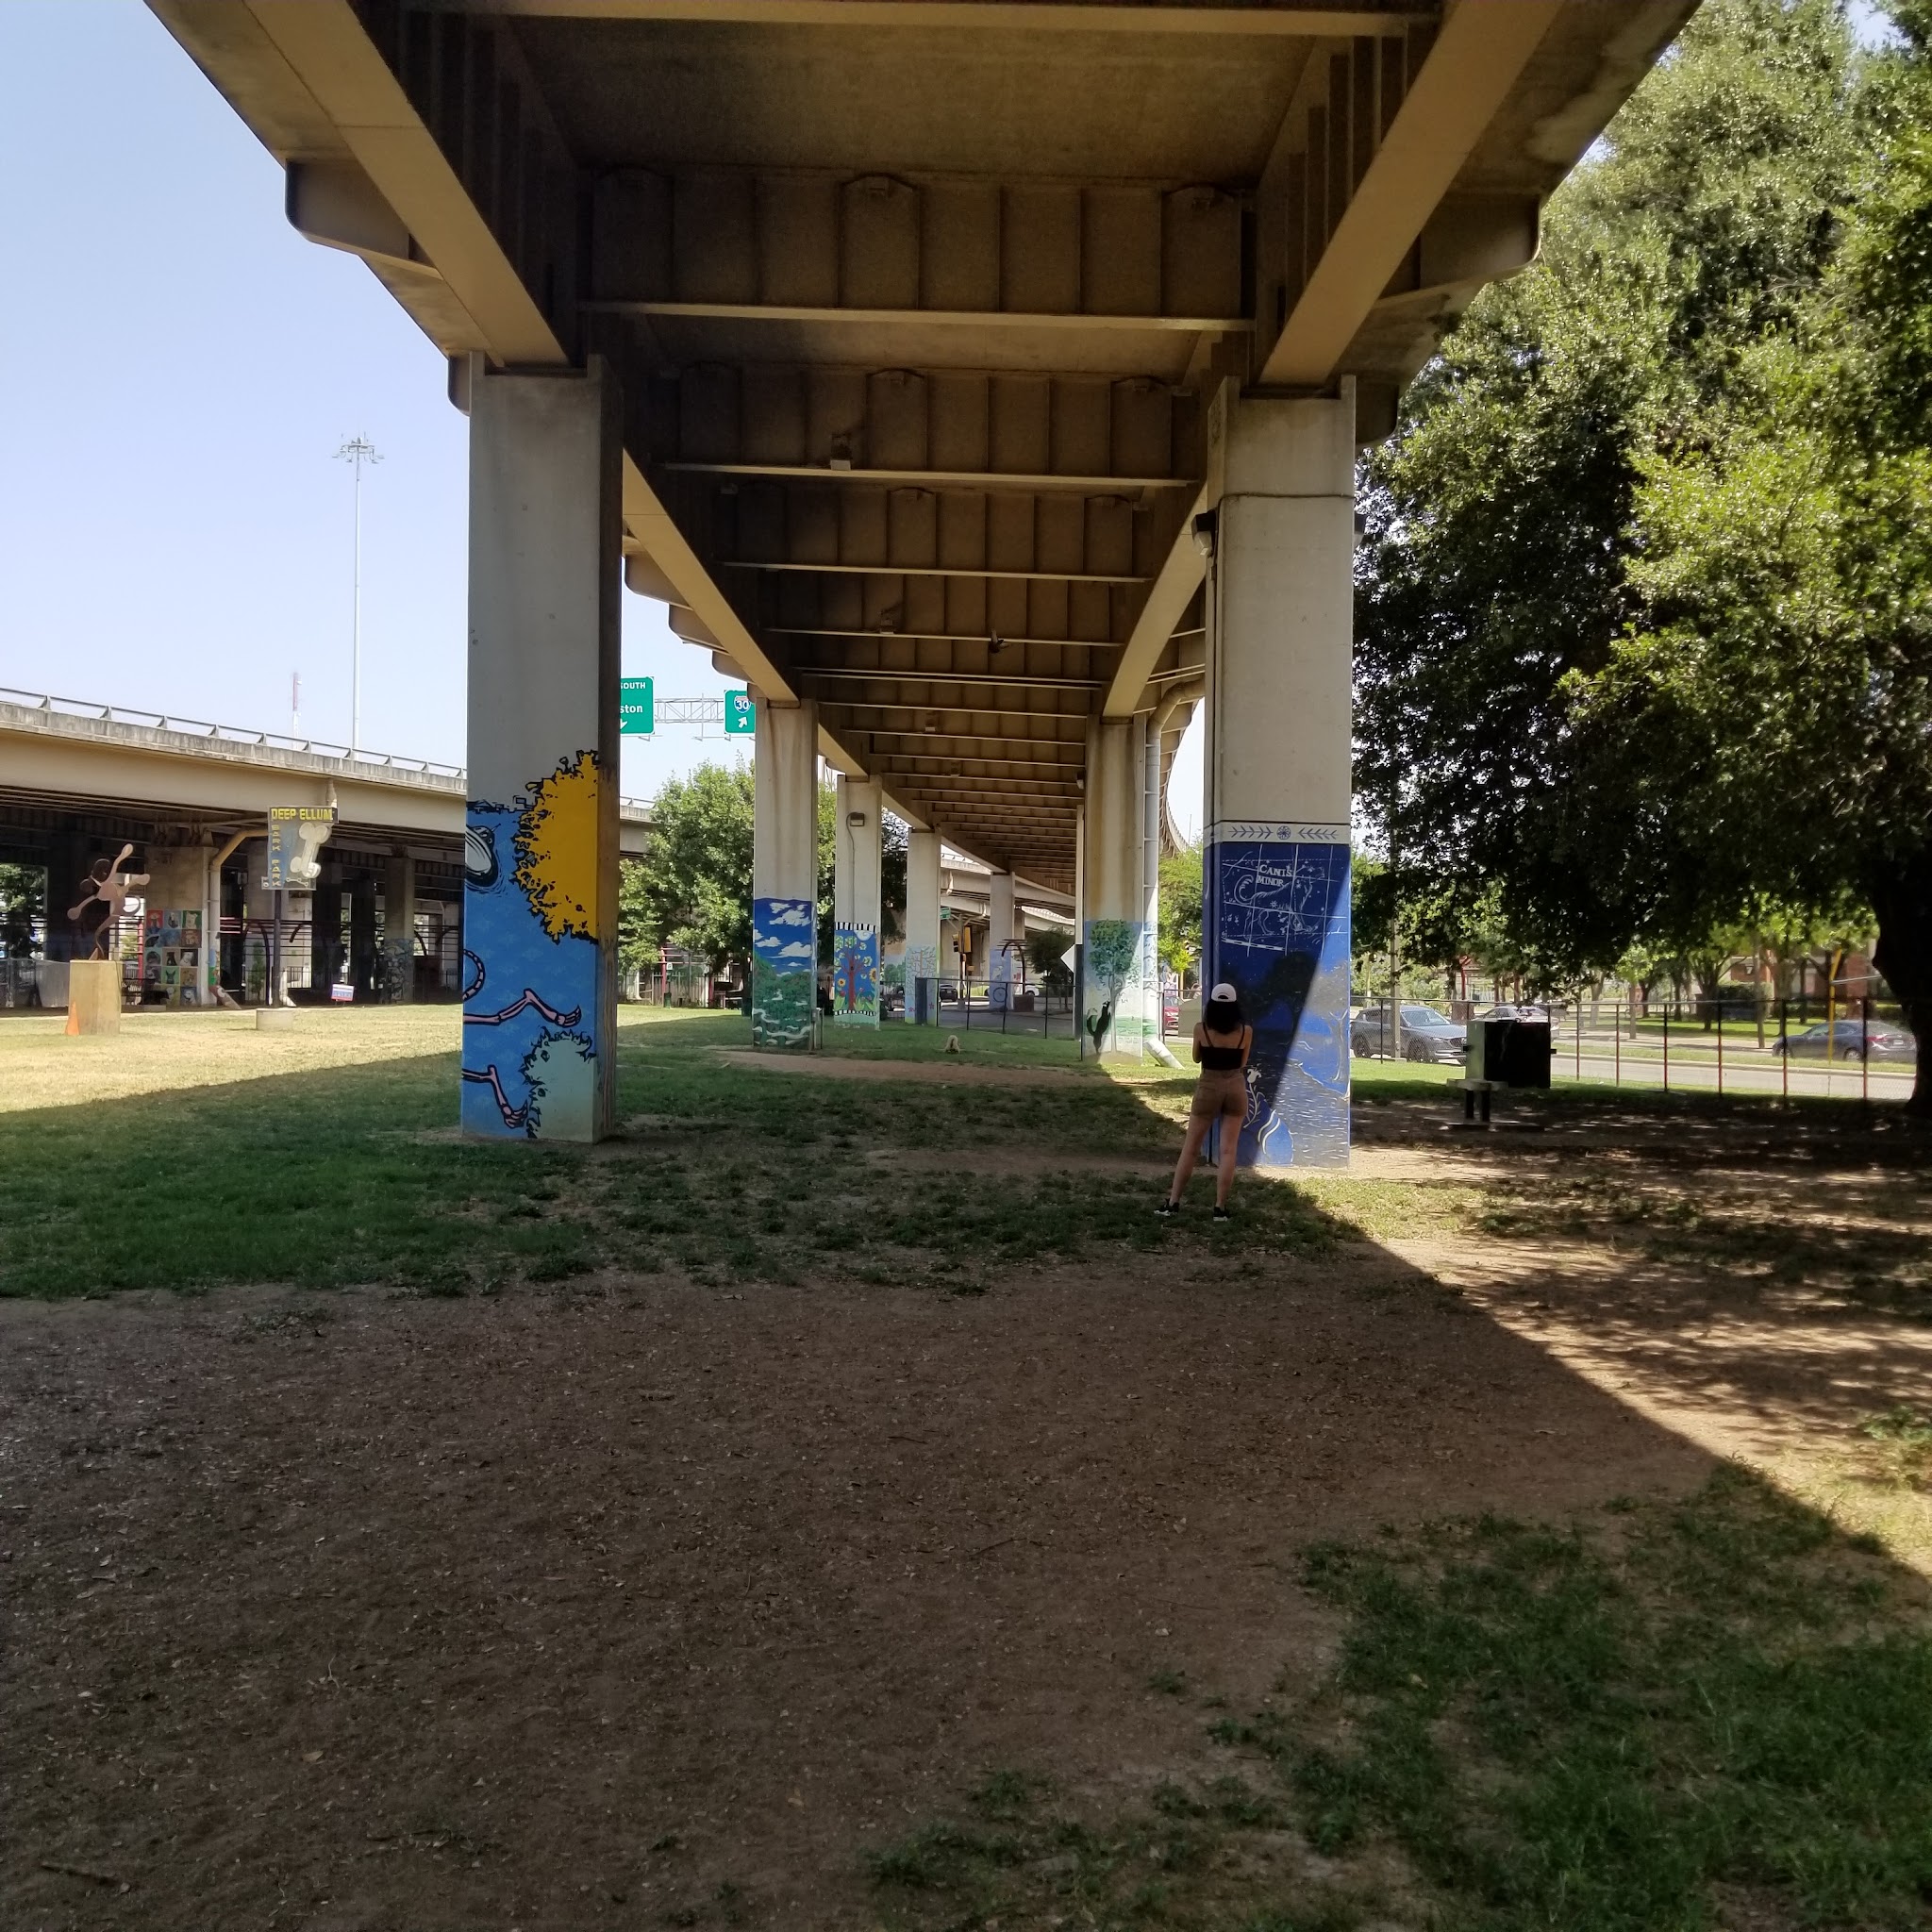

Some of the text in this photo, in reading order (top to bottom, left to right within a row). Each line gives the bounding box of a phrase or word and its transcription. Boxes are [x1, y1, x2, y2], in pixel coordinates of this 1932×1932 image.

[736, 700, 749, 709] 30
[271, 808, 333, 820] DEEP ELLUM
[272, 824, 281, 887] BARK PARK
[1259, 864, 1292, 877] CANIS
[1257, 875, 1284, 887] MINOR
